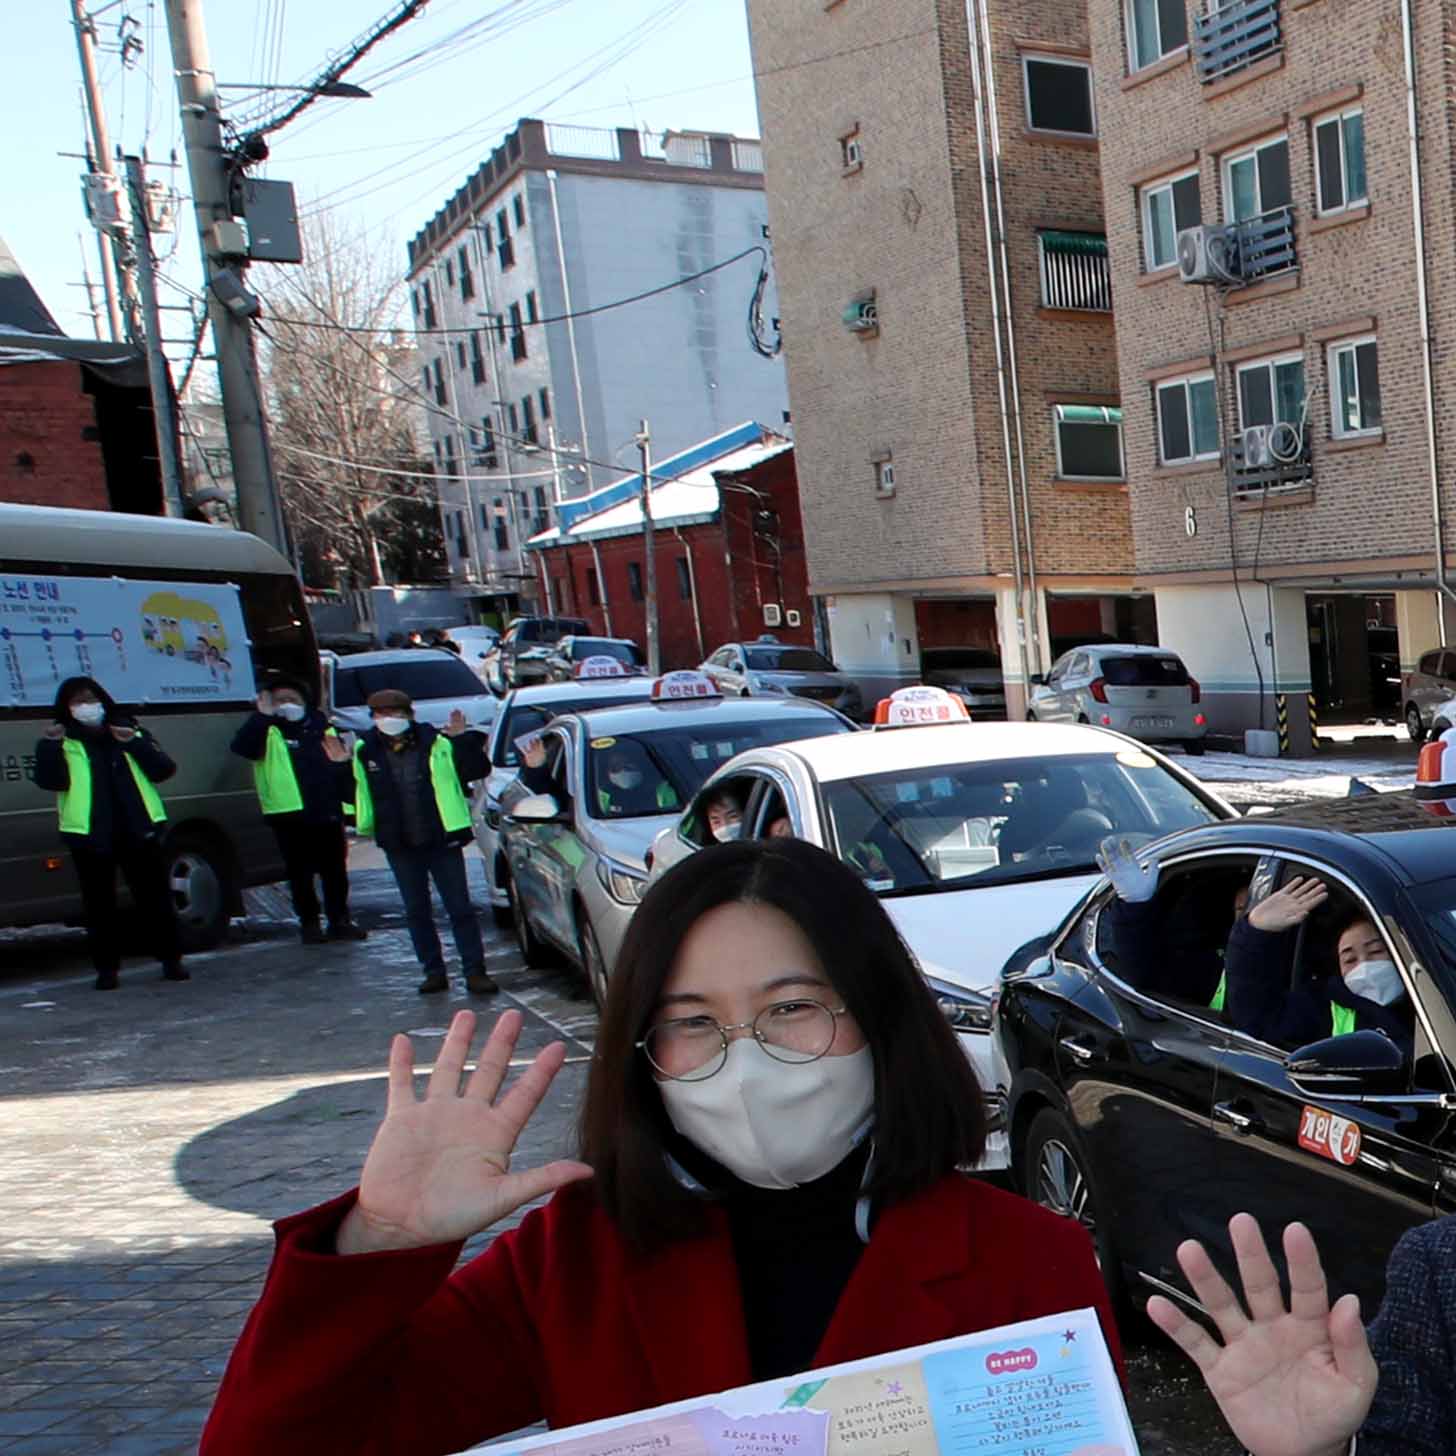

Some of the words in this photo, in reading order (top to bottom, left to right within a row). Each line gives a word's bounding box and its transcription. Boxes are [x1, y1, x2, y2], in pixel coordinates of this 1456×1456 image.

[1185, 506, 1197, 537] 6
[668, 684, 708, 697] 인천콜
[900, 704, 951, 723] 인천콜
